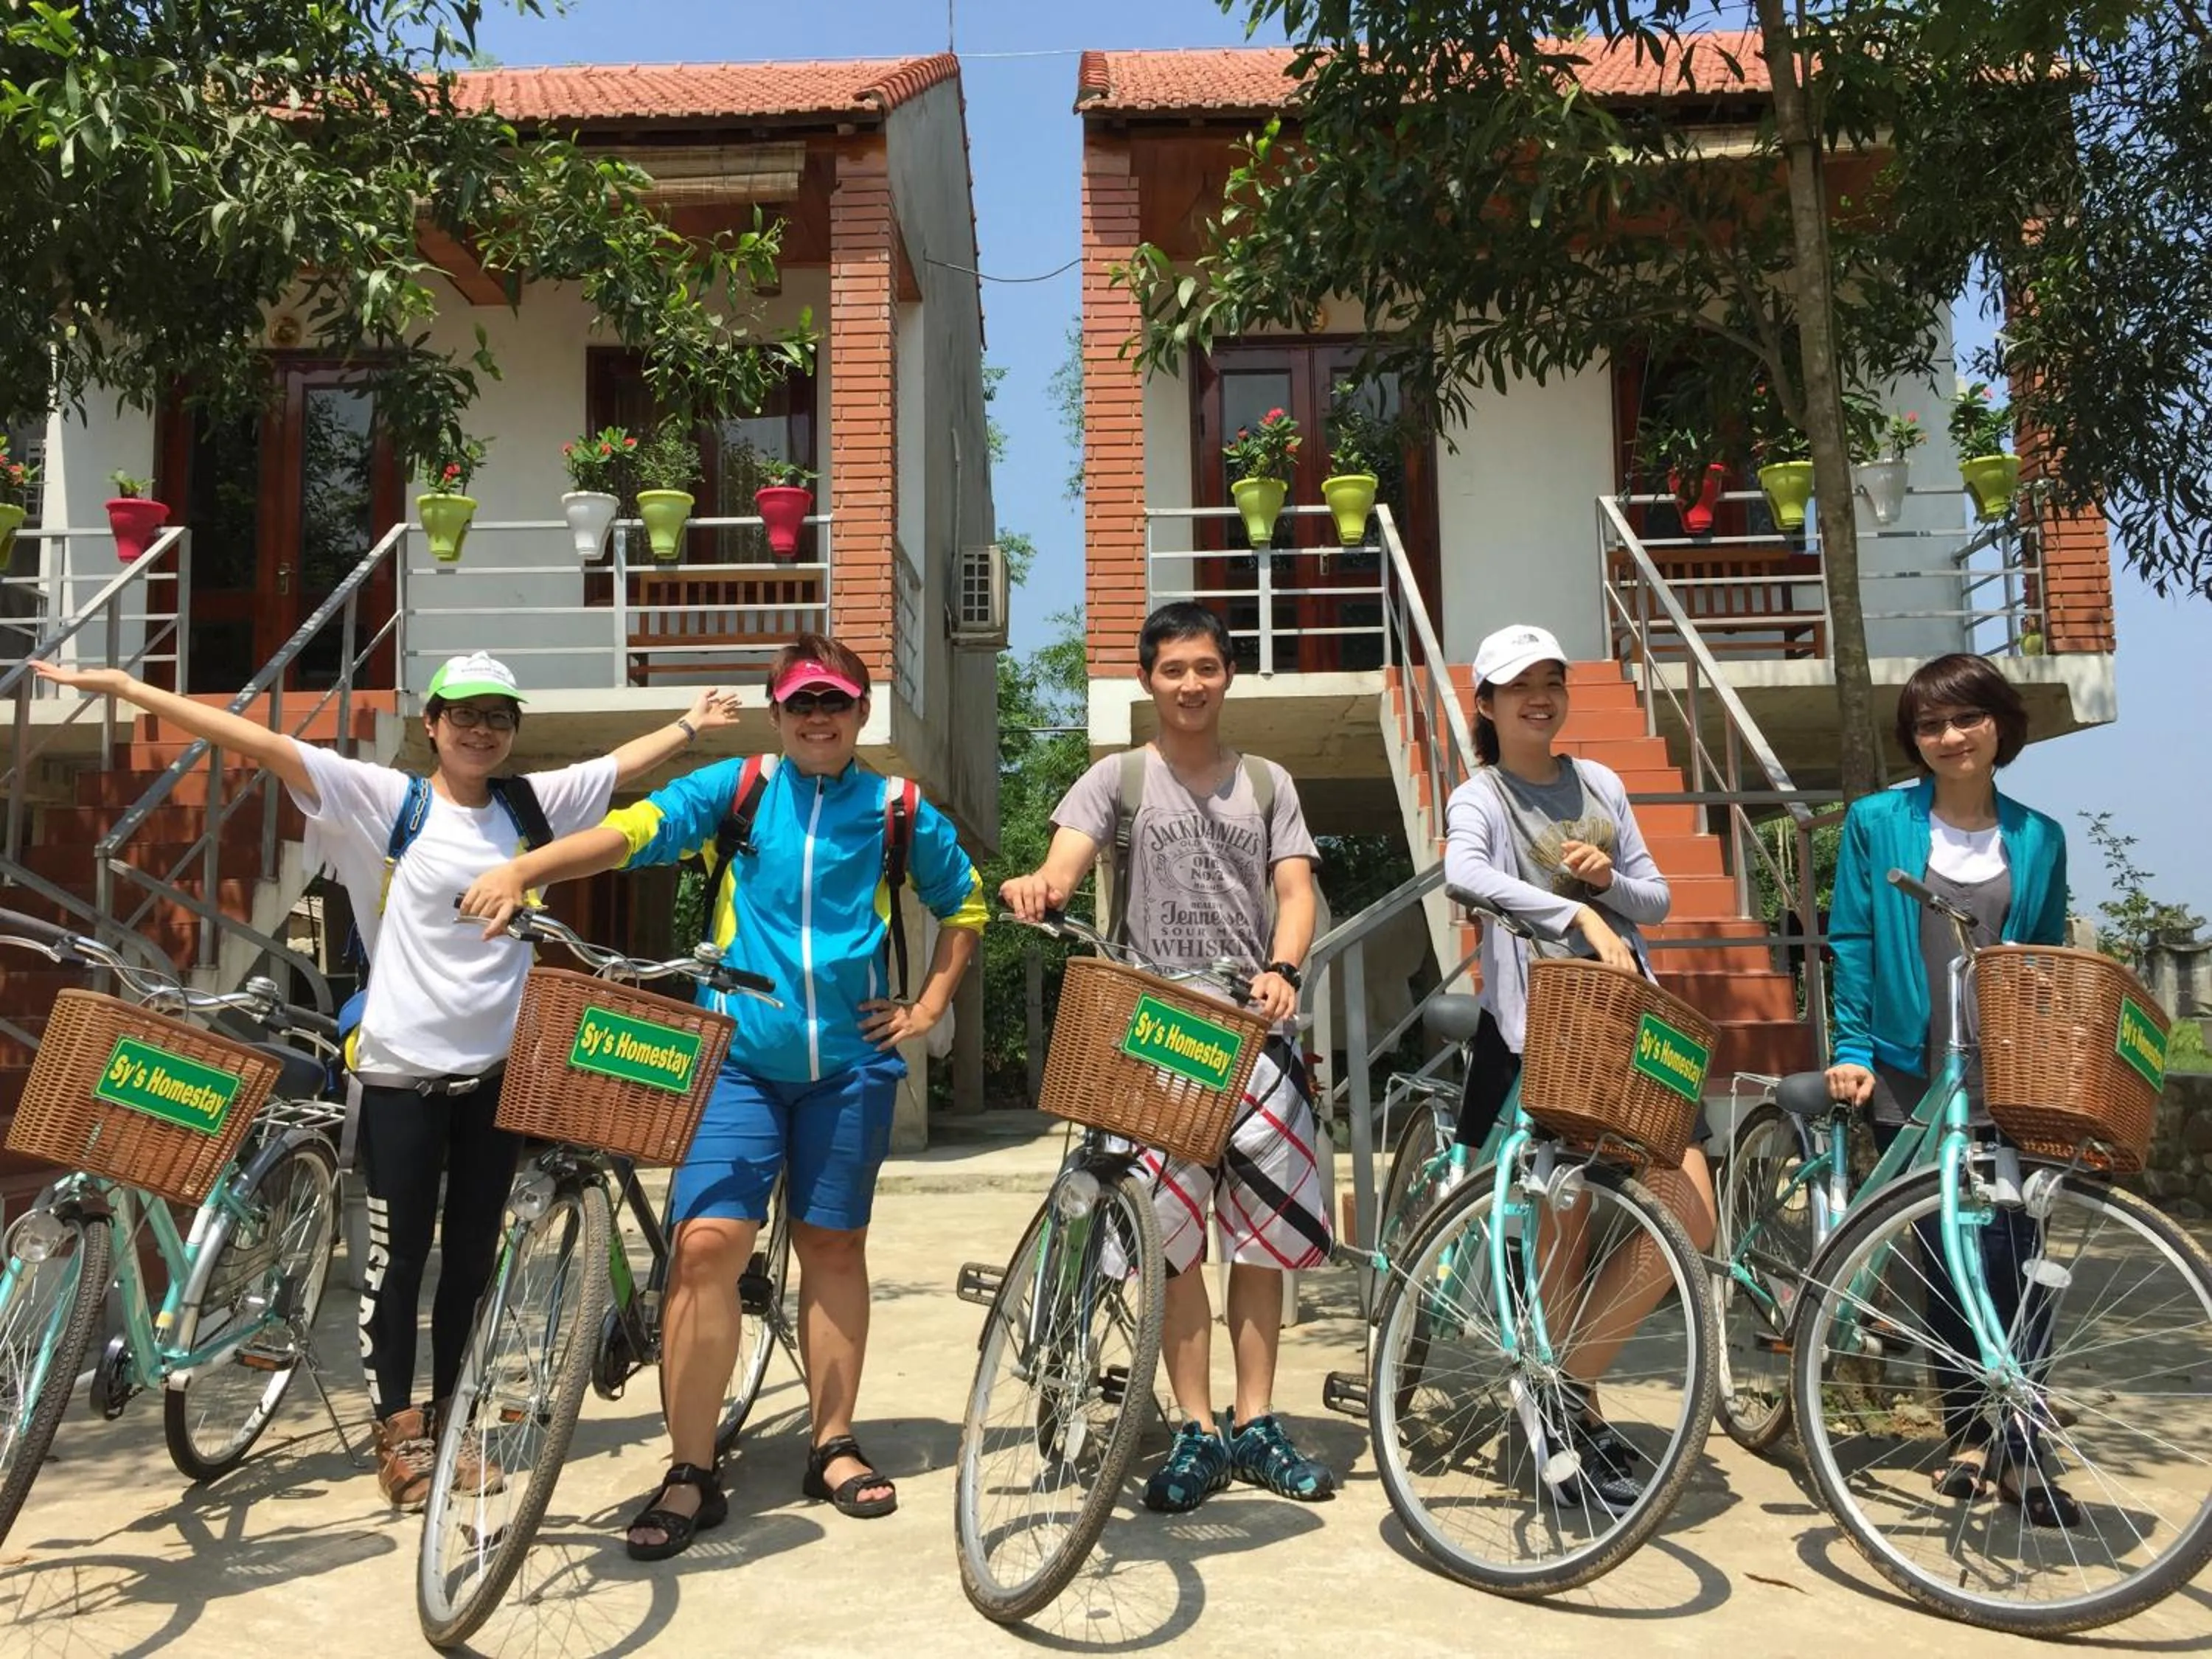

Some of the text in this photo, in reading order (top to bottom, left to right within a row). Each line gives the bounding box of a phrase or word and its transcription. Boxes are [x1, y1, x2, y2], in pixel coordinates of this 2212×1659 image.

[1148, 819, 1192, 852] JACK
[1160, 900, 1251, 926] Tennese
[1151, 939, 1251, 957] WHISKE
[580, 1021, 692, 1080] Sy's Homestay
[1135, 1011, 1232, 1077] Sy's Homestay
[1641, 1028, 1703, 1090] Sy's Homestay
[109, 1054, 227, 1120] Sy's Homestay
